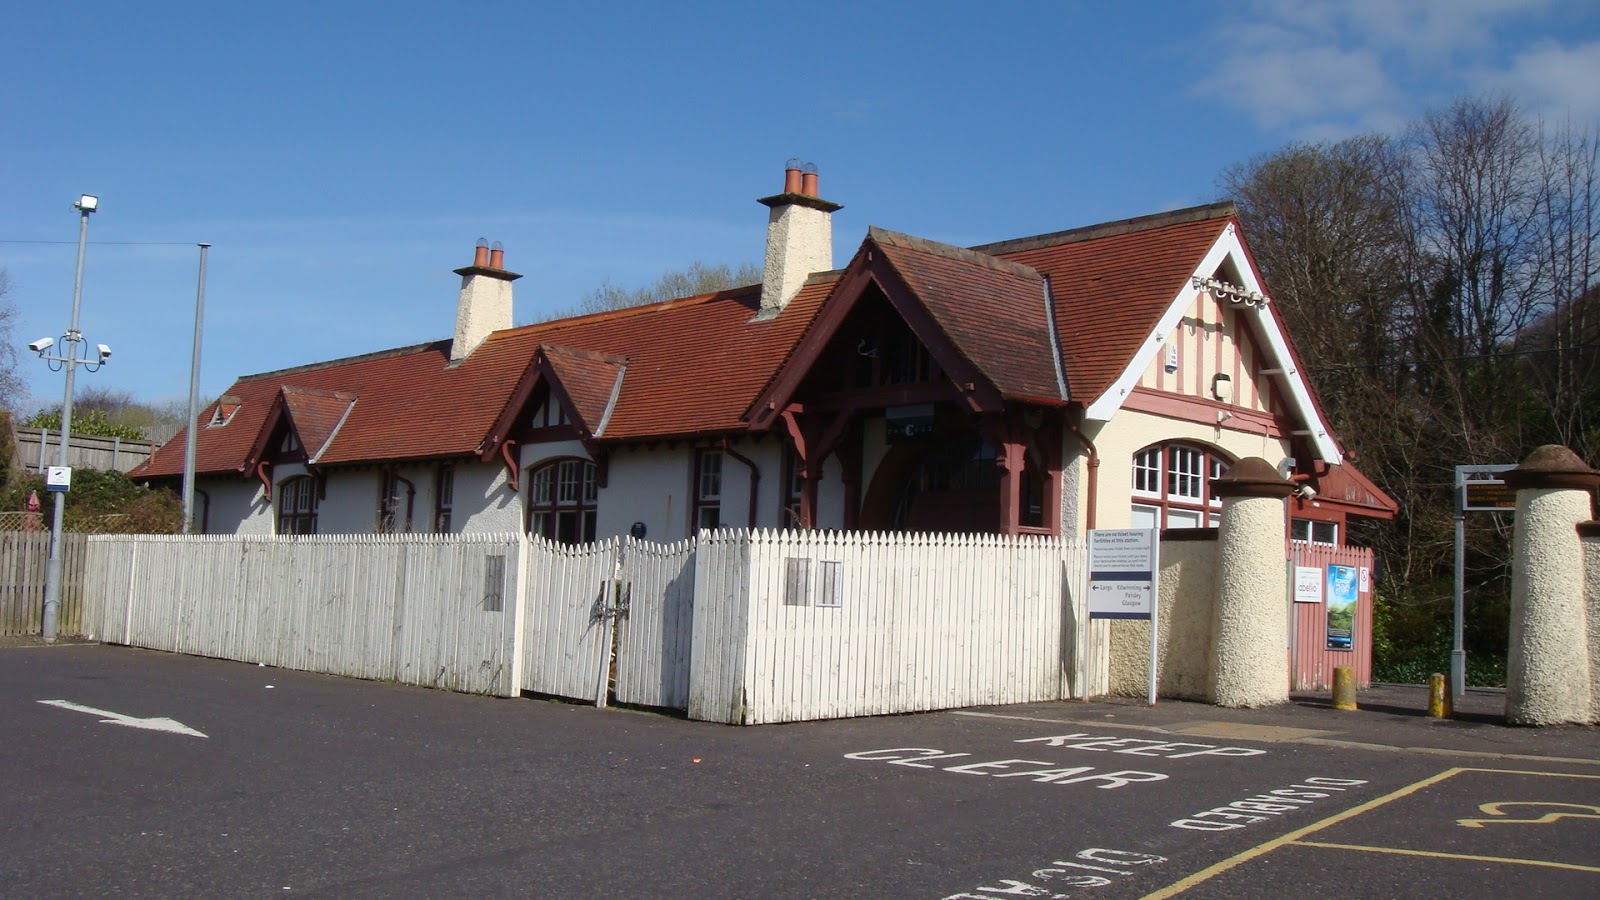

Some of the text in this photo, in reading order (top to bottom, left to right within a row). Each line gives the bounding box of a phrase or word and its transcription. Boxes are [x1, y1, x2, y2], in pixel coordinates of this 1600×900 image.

[1116, 584, 1142, 592] Kilwinning
[1125, 592, 1142, 600] Paisley
[1014, 733, 1267, 760] KEEP
[843, 747, 1170, 790] CLEAR
[1169, 776, 1369, 832] DISABLED
